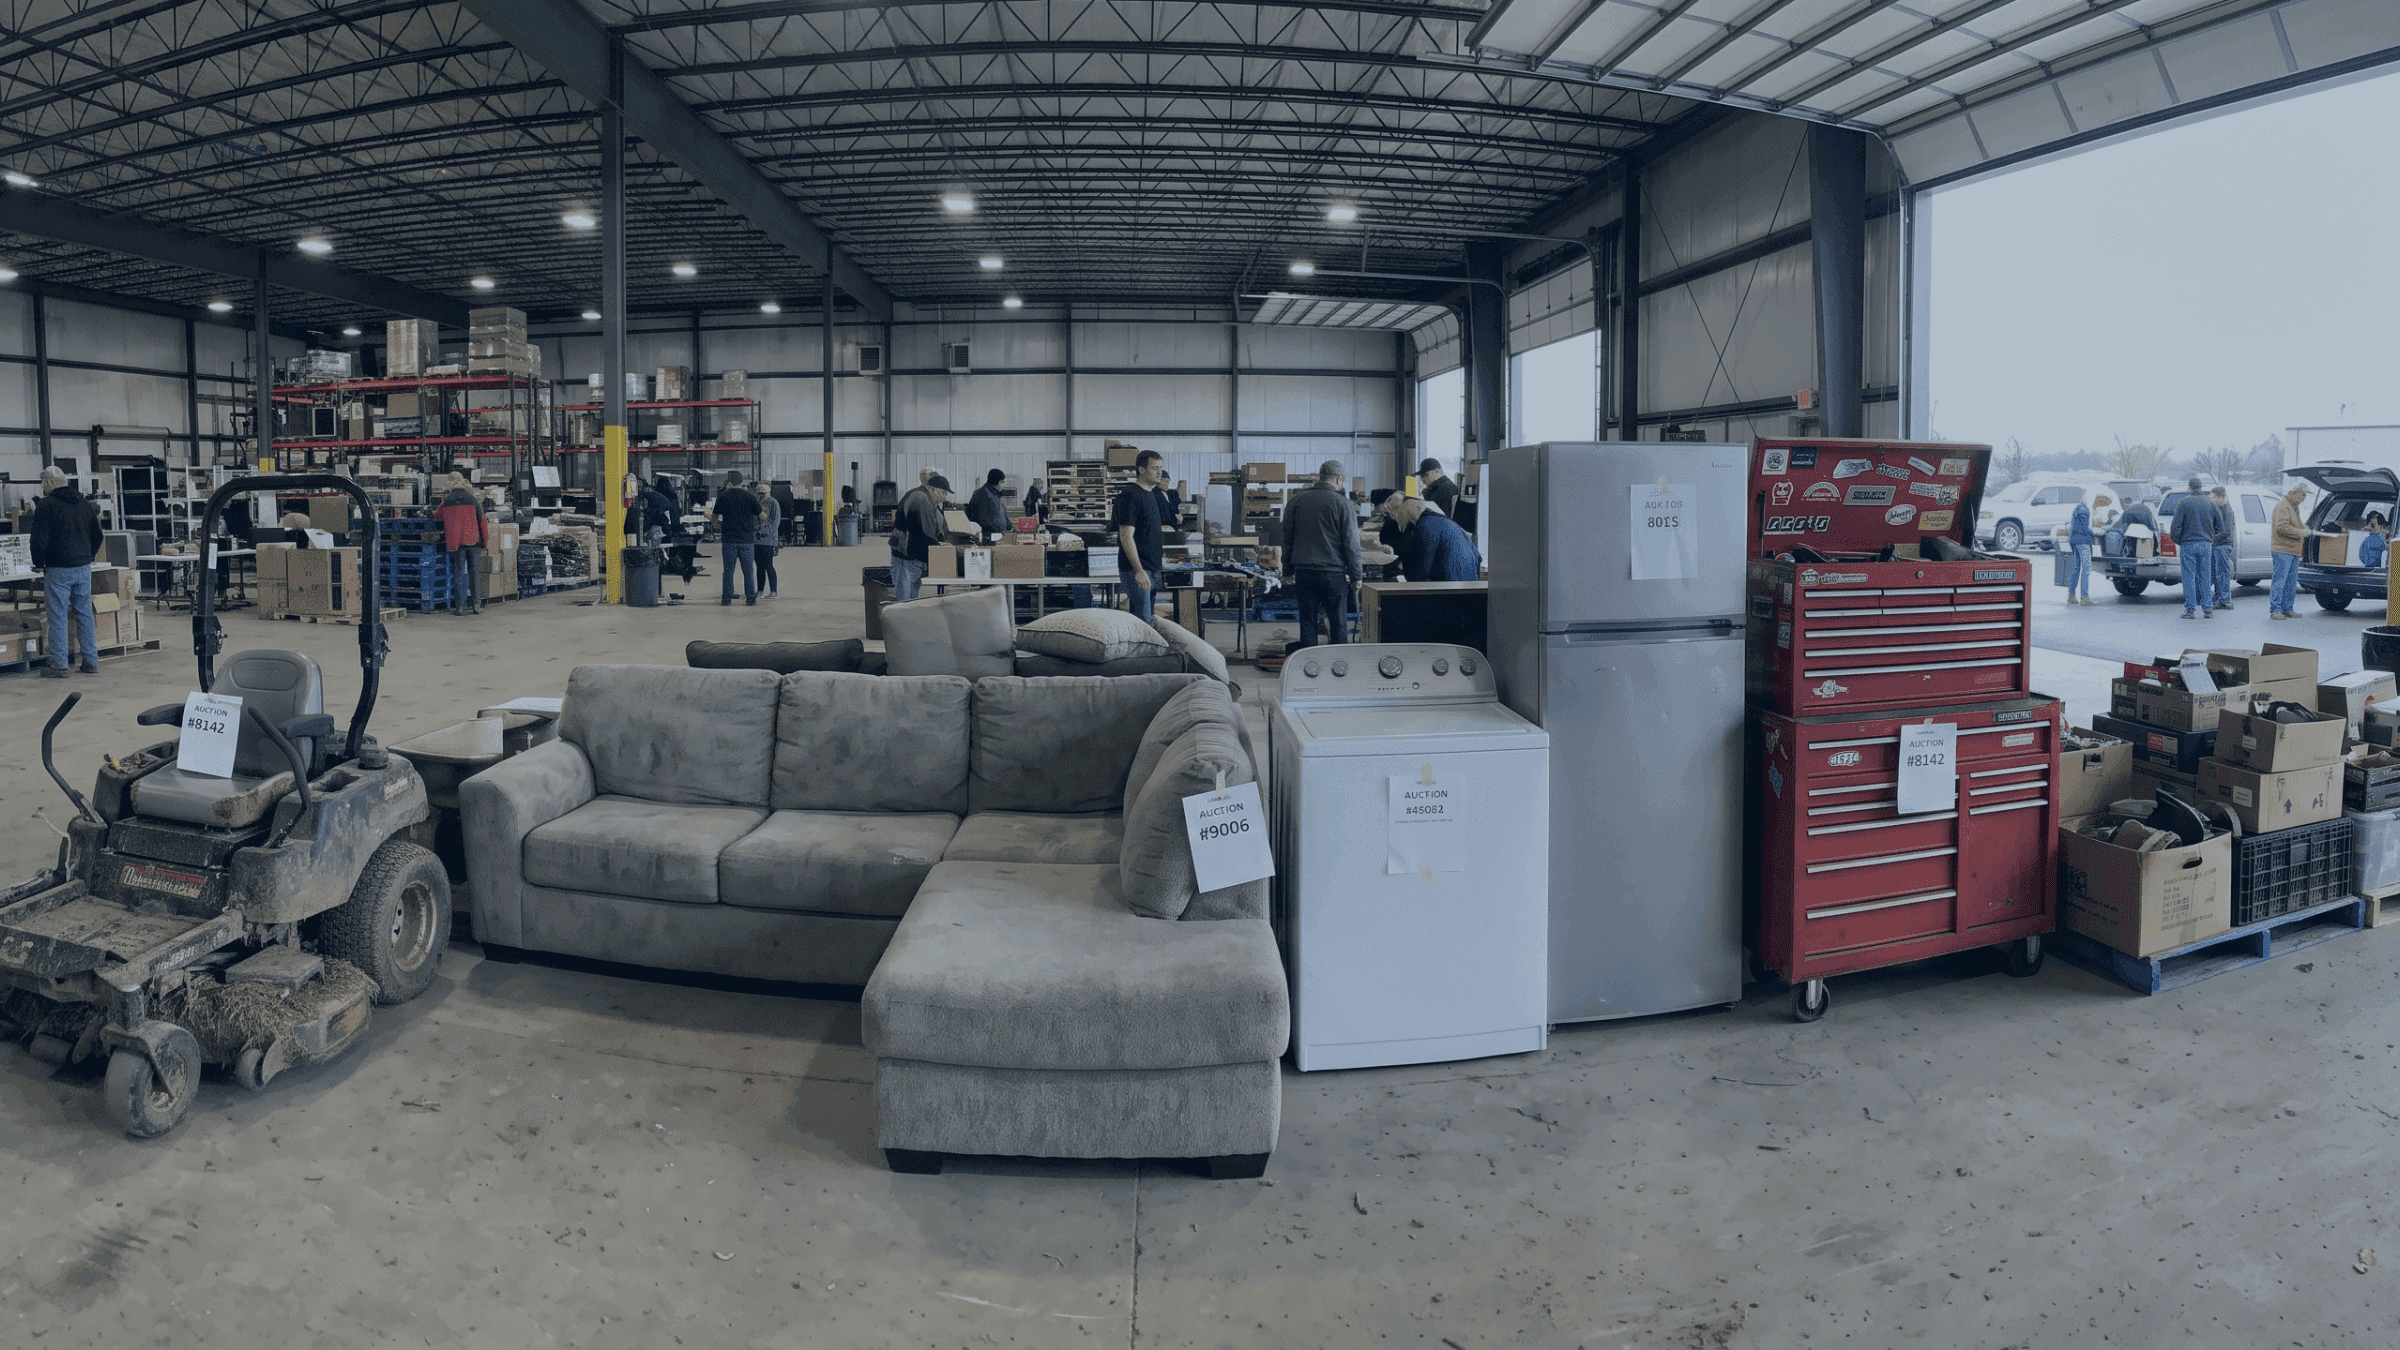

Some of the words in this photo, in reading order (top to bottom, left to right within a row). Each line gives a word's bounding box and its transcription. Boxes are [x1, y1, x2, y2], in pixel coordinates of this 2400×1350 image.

[194, 705, 228, 717] AUCTION
[188, 717, 225, 734] #8142
[1909, 739, 1944, 748] AUCTION
[1907, 753, 1945, 767] #8142
[1404, 790, 1448, 800] AUCTION
[1200, 803, 1244, 819] AUCTION
[1200, 819, 1250, 841] #9006
